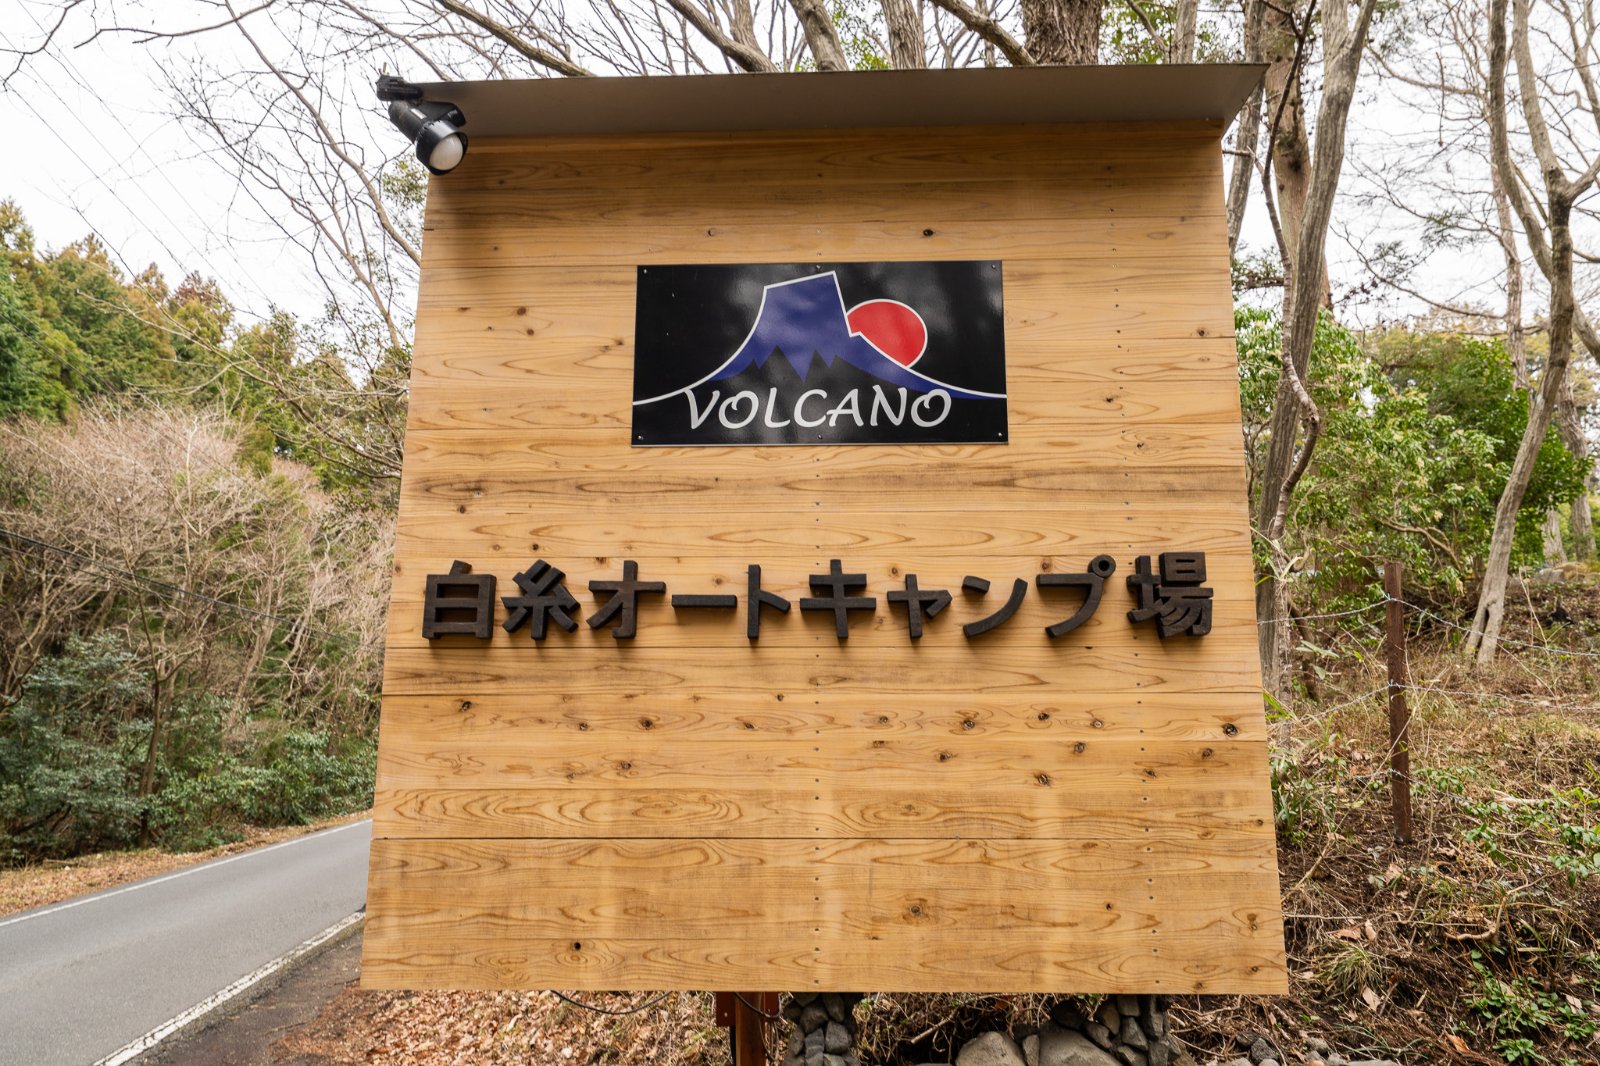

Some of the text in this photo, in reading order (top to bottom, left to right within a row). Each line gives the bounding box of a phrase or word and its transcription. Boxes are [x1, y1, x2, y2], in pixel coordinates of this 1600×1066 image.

[684, 384, 952, 430] VOLCANO
[422, 551, 1214, 641] 白糸オートキャンプ場
